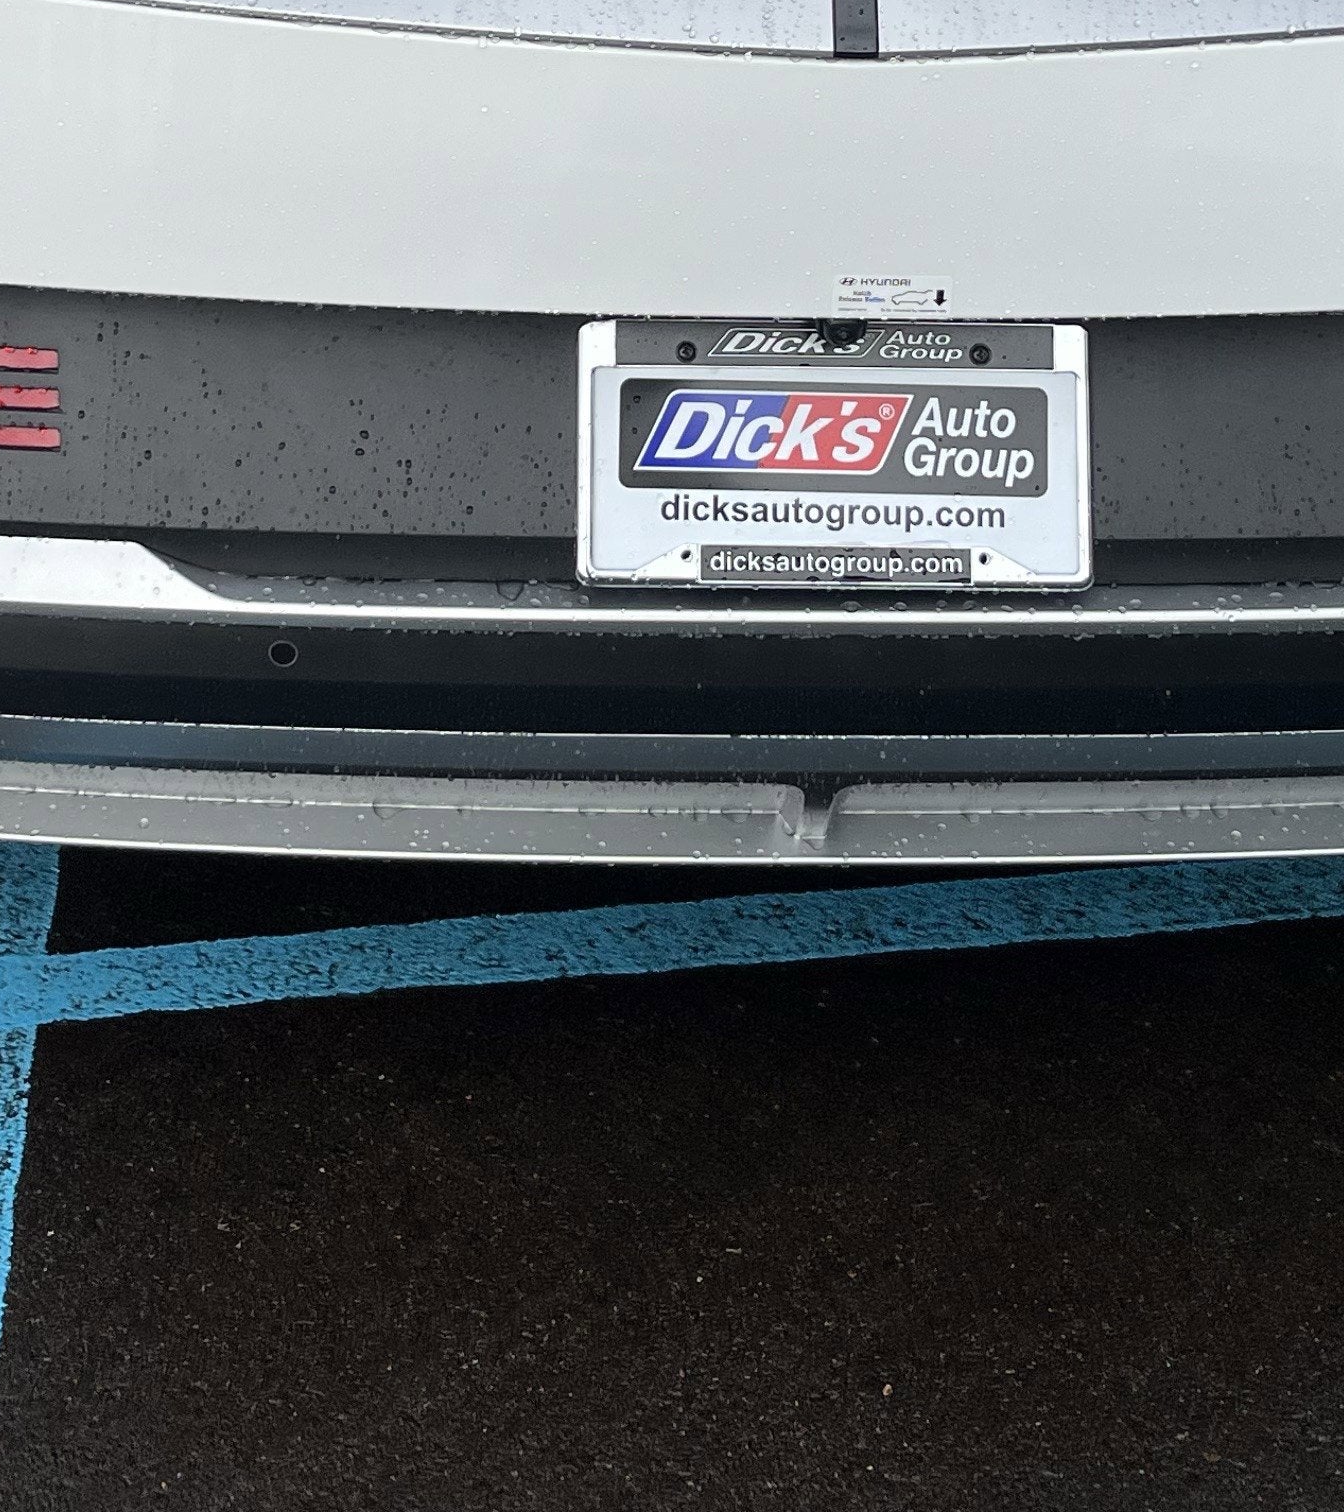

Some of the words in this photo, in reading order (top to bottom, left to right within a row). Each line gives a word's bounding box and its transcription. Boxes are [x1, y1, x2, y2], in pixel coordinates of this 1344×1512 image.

[860, 278, 912, 287] HYUNDAI
[884, 330, 952, 346] Auto
[878, 344, 964, 363] Group
[911, 397, 1017, 439] Auto
[903, 437, 1035, 488] Group
[660, 493, 1006, 533] dicksautogroup.com
[709, 550, 964, 578] dicksautogroup.com
